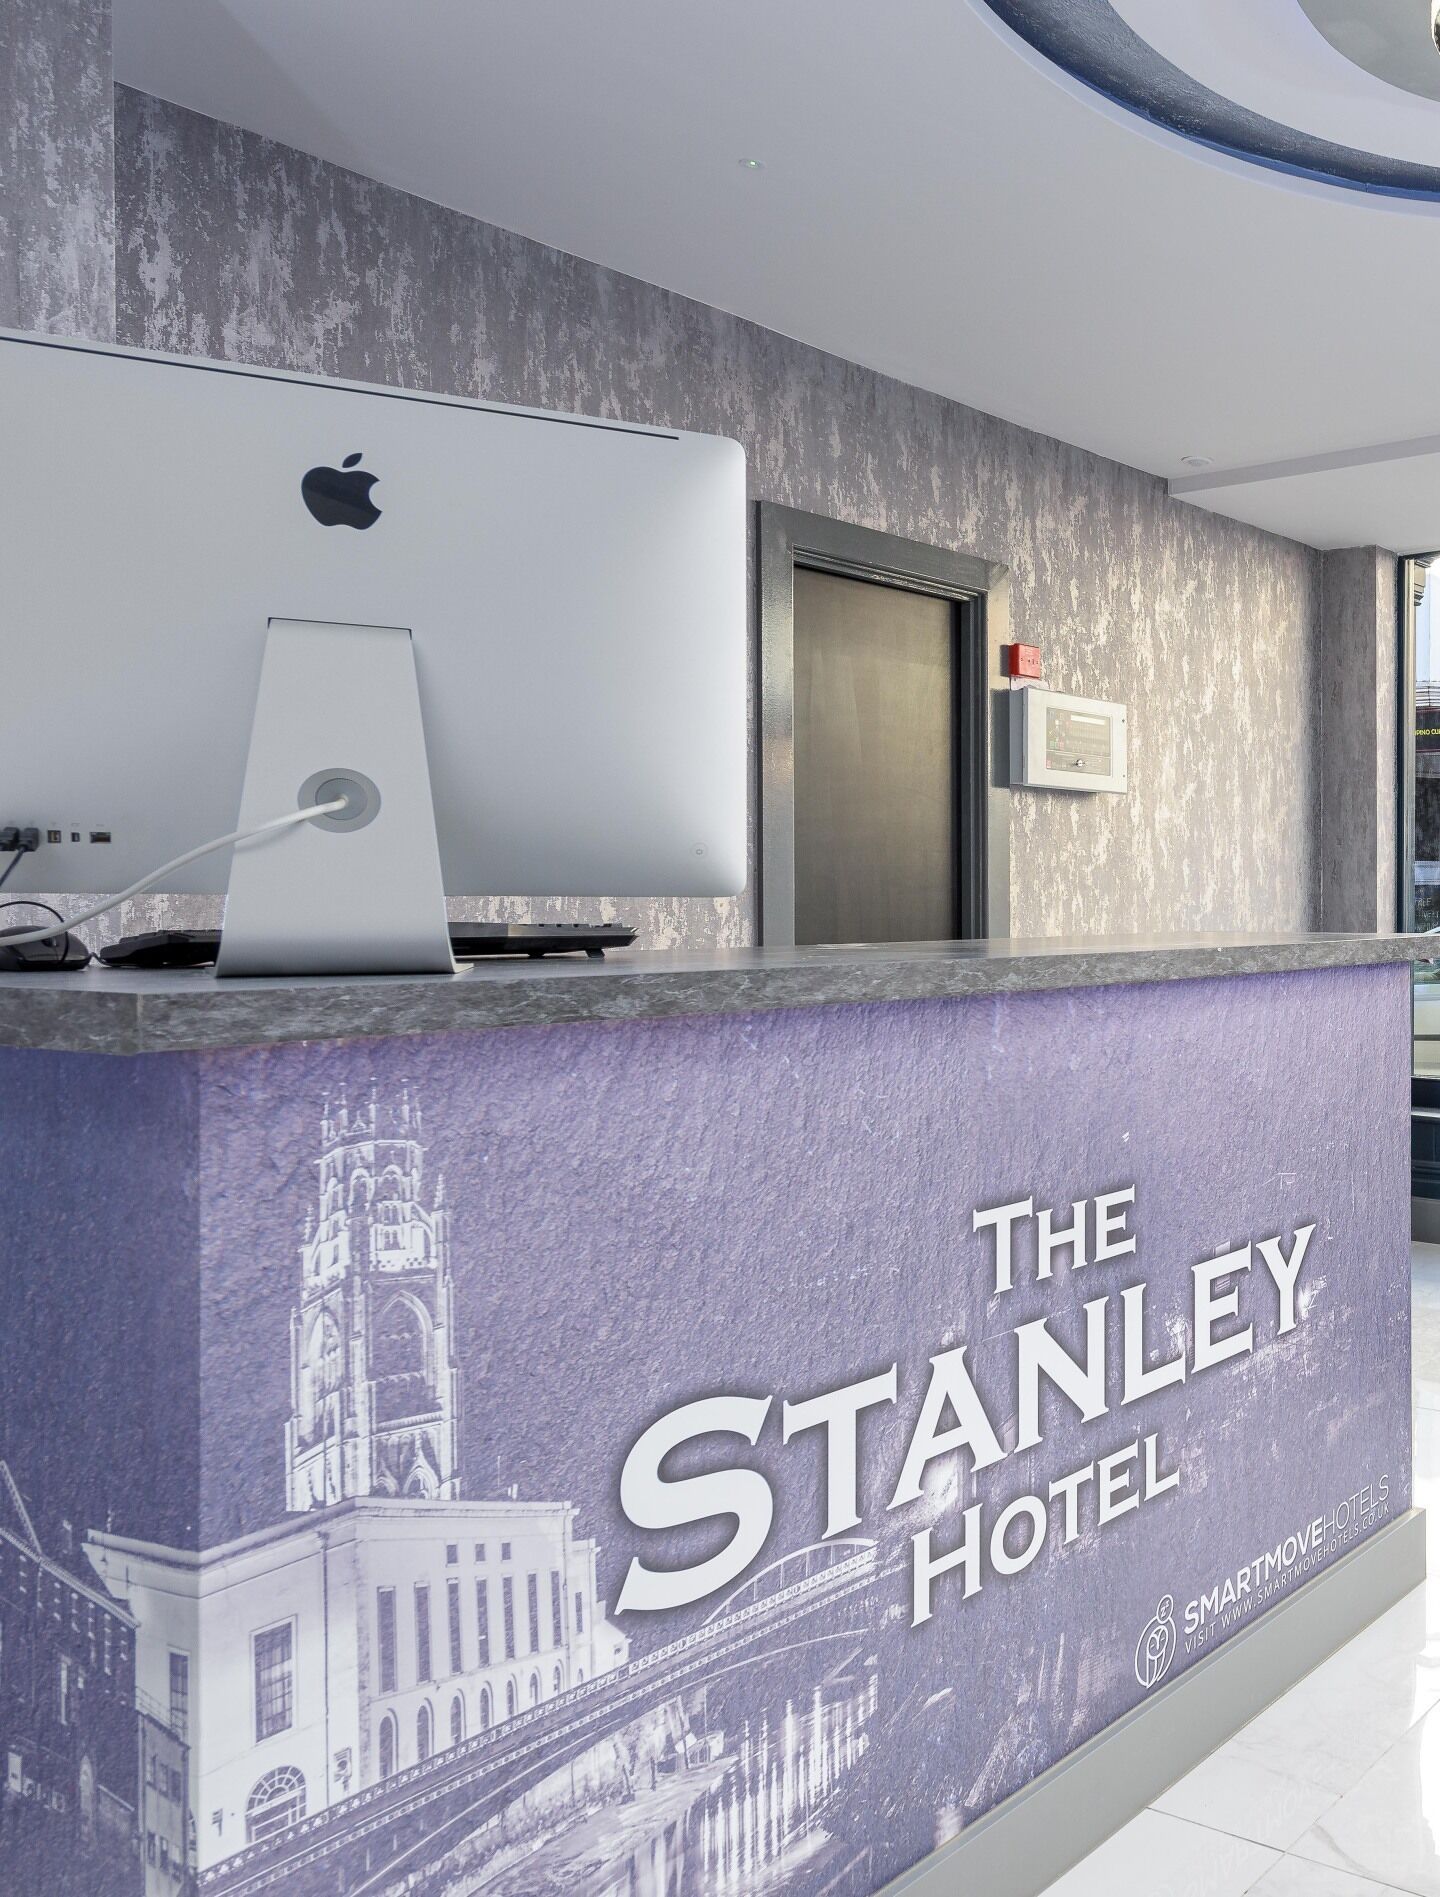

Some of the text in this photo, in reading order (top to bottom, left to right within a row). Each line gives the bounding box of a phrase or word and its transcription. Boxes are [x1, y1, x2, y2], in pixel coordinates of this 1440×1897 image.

[972, 1184, 1137, 1294] THE
[614, 1223, 1317, 1616] STANLEY
[910, 1432, 1180, 1628] HOTEL
[1184, 1474, 1390, 1635] SMARTMOVEHOTELS
[1184, 1501, 1390, 1654] VISIT WWW.SMARTMOVEHOTELS.CO.UK
